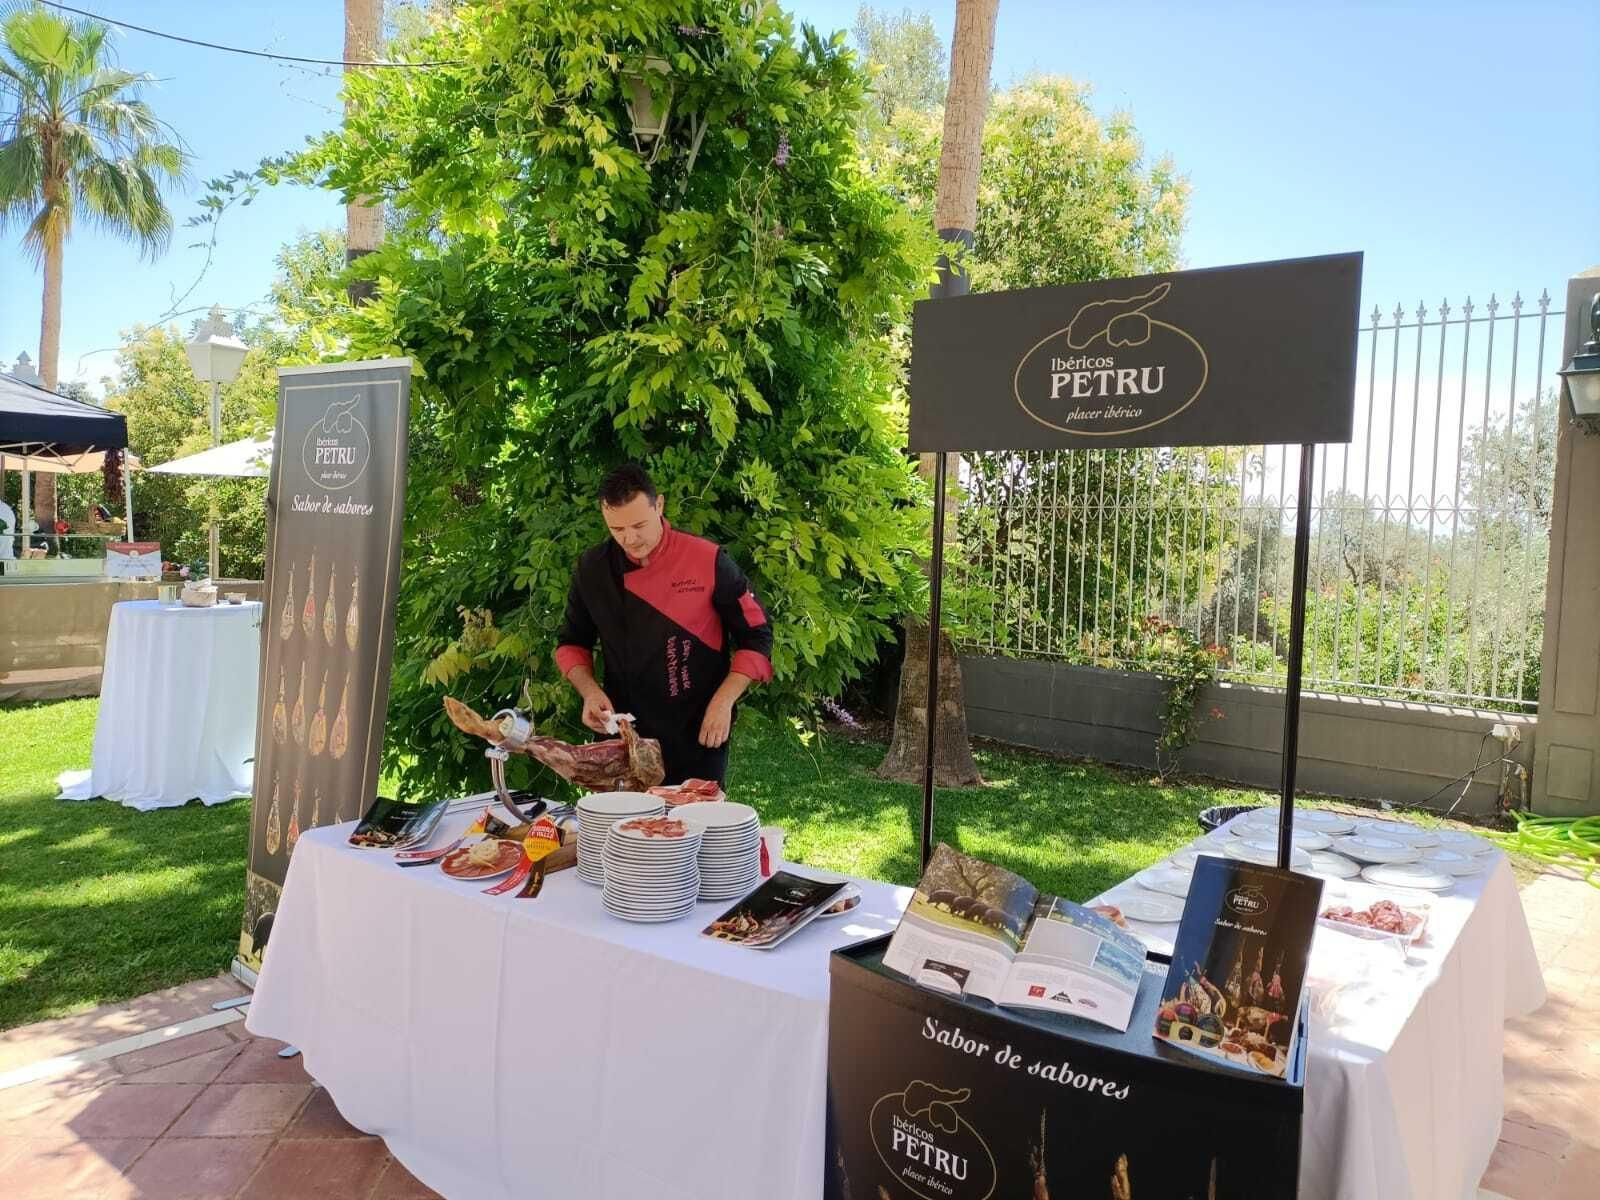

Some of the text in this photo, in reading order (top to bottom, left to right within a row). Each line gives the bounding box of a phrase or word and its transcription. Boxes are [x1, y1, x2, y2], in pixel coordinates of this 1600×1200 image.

[1051, 355, 1114, 371] Ibéricos
[1050, 366, 1166, 399] PETRU
[1066, 404, 1142, 424] placer ibérico
[314, 447, 356, 465] PETRU
[291, 493, 374, 515] Sabor de sabores
[1233, 897, 1260, 909] PETRU
[922, 1016, 1130, 1100] Sabor de sabores
[892, 1114, 934, 1143] Ibéricos
[892, 1127, 968, 1181] PETRU
[902, 1165, 953, 1196] placer ibérico
